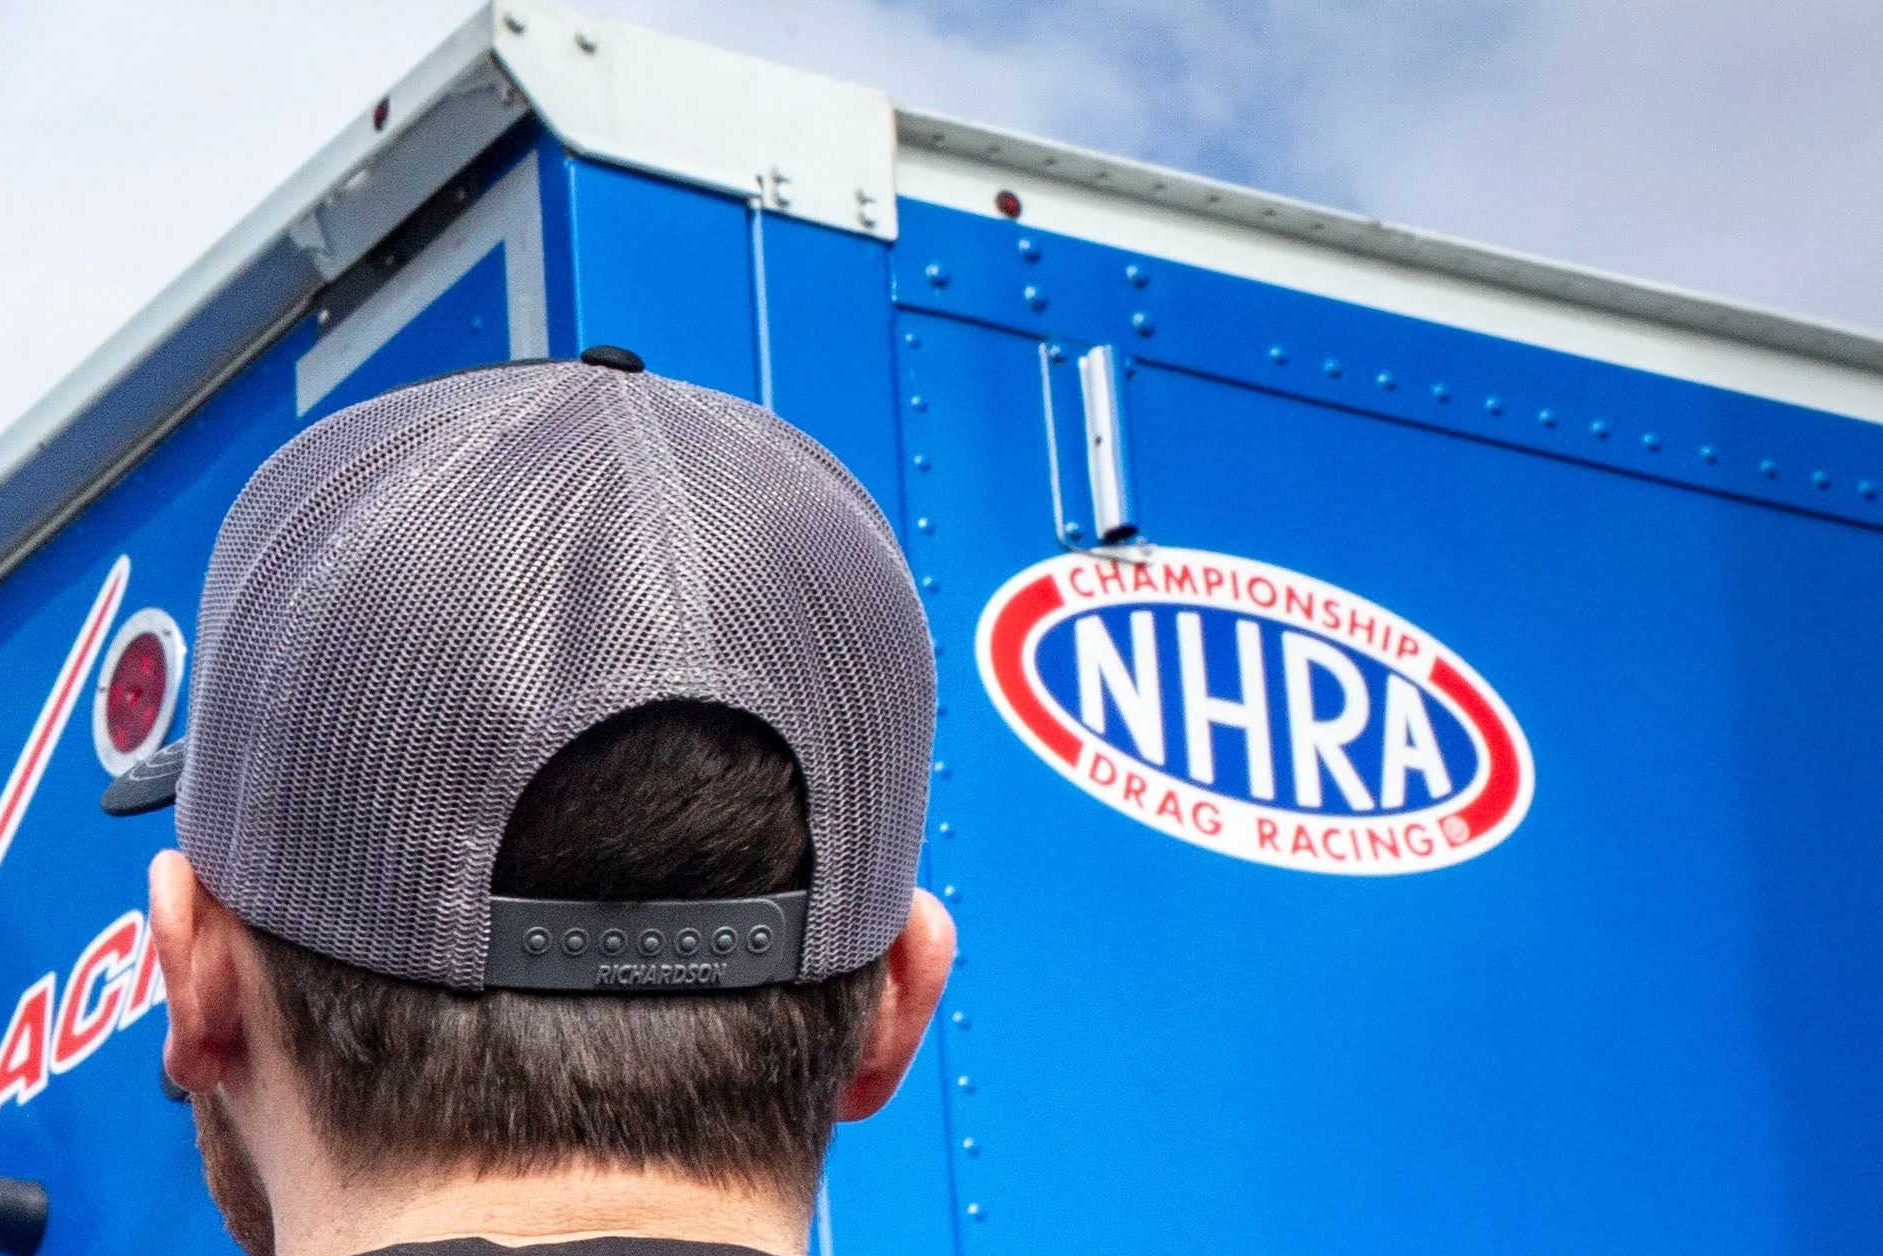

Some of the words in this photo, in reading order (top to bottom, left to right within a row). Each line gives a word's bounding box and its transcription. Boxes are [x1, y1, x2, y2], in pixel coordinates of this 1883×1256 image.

[1068, 560, 1419, 661] CHAMPIONSHIP
[1074, 610, 1452, 812] NHRA
[1088, 752, 1223, 837] DRAG
[1257, 816, 1434, 863] RACING
[595, 962, 728, 986] RICHARDSON
